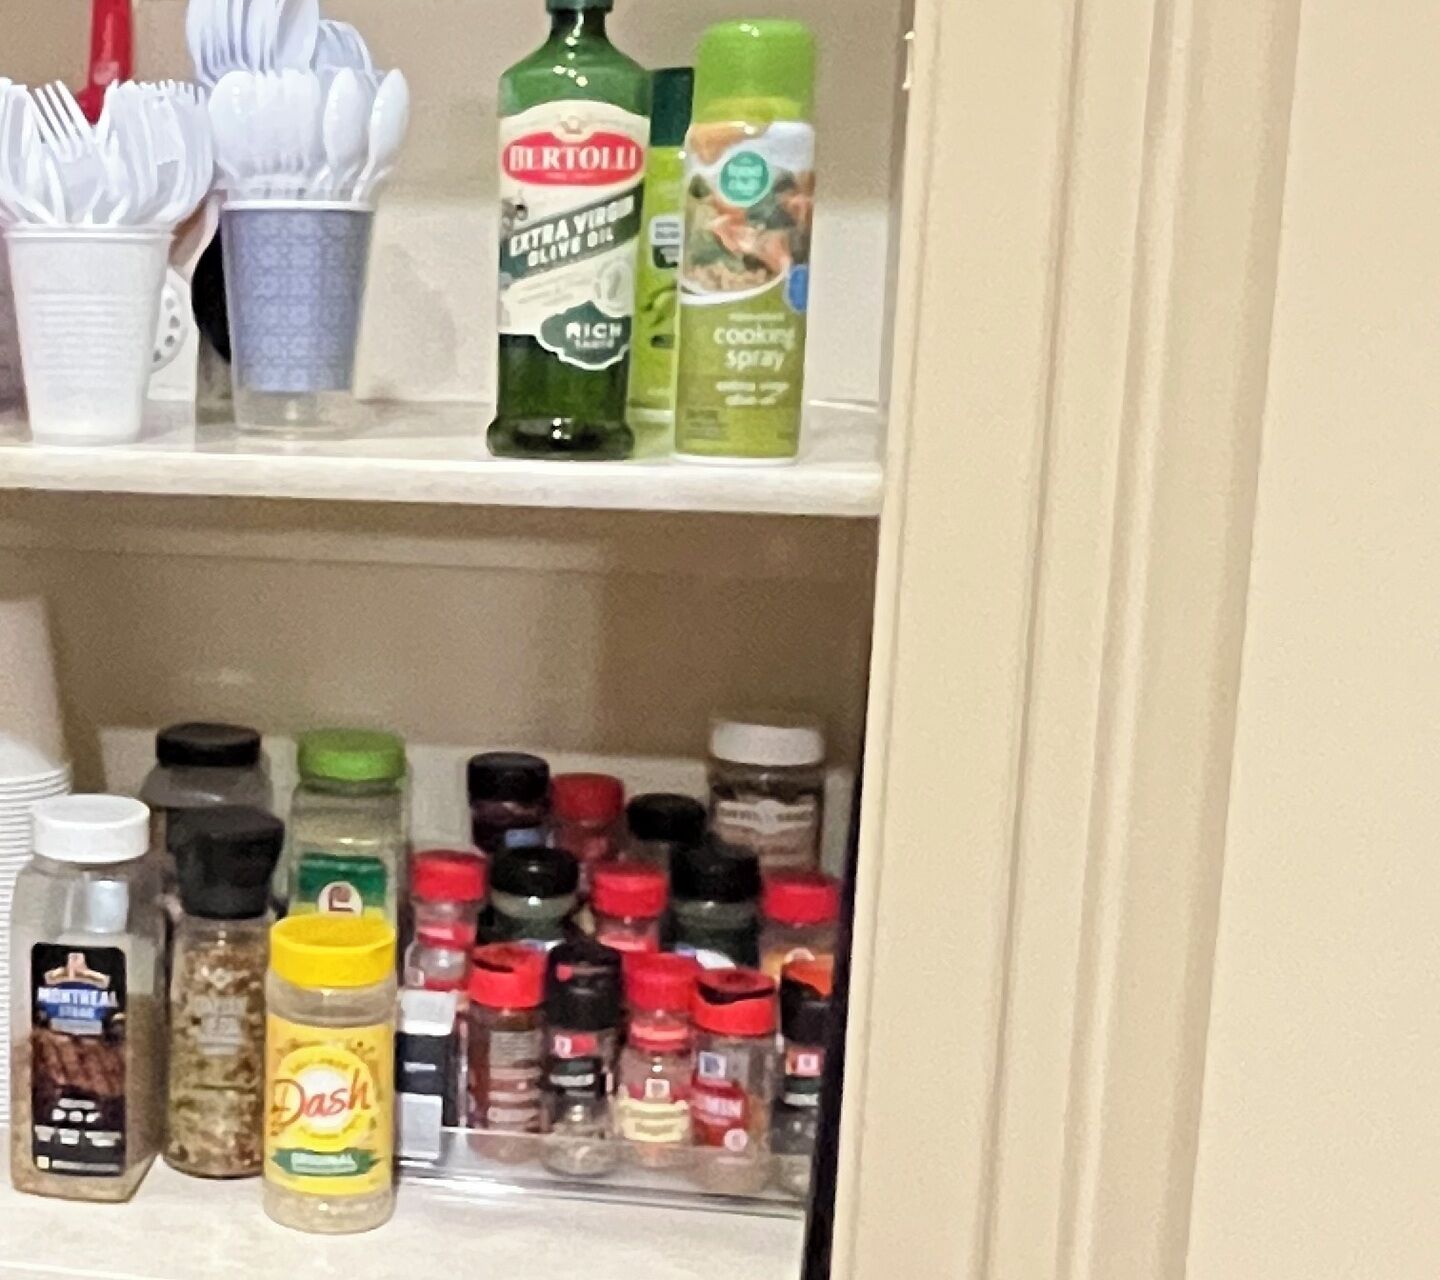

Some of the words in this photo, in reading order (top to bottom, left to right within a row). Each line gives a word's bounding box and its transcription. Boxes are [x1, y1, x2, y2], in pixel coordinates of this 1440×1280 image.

[509, 145, 636, 170] BERTOLLI
[510, 219, 569, 257] EXTRA
[573, 195, 635, 234] VIRGIN
[528, 237, 581, 267] OLIVE
[587, 227, 614, 248] OIL
[565, 322, 623, 339] RICH
[713, 323, 796, 350] cooking
[725, 349, 785, 372] spray
[37, 987, 119, 1008] MONTREAL
[271, 1068, 371, 1127] Dash
